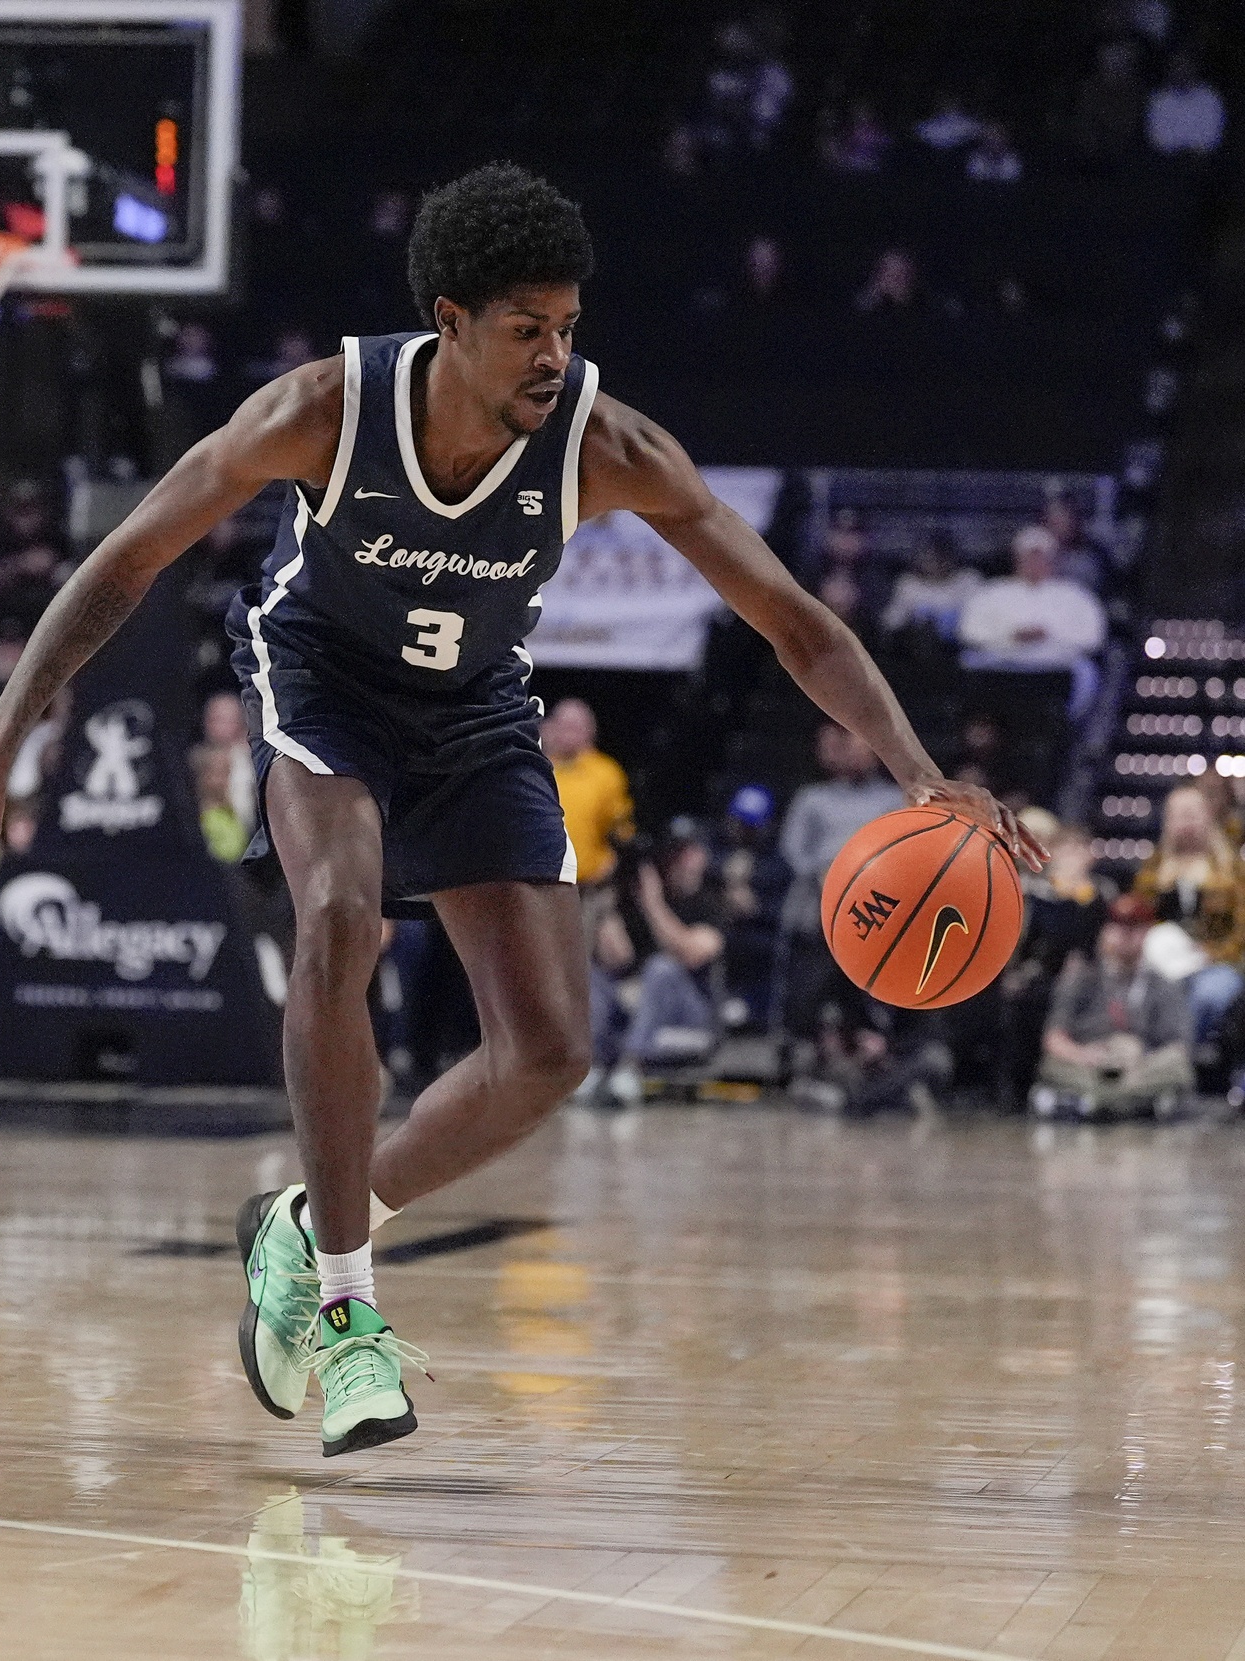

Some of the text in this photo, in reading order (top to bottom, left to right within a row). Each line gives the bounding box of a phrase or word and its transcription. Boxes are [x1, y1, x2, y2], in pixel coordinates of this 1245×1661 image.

[354, 533, 538, 585] Longwood
[401, 608, 465, 671] 3
[848, 889, 901, 941] WF
